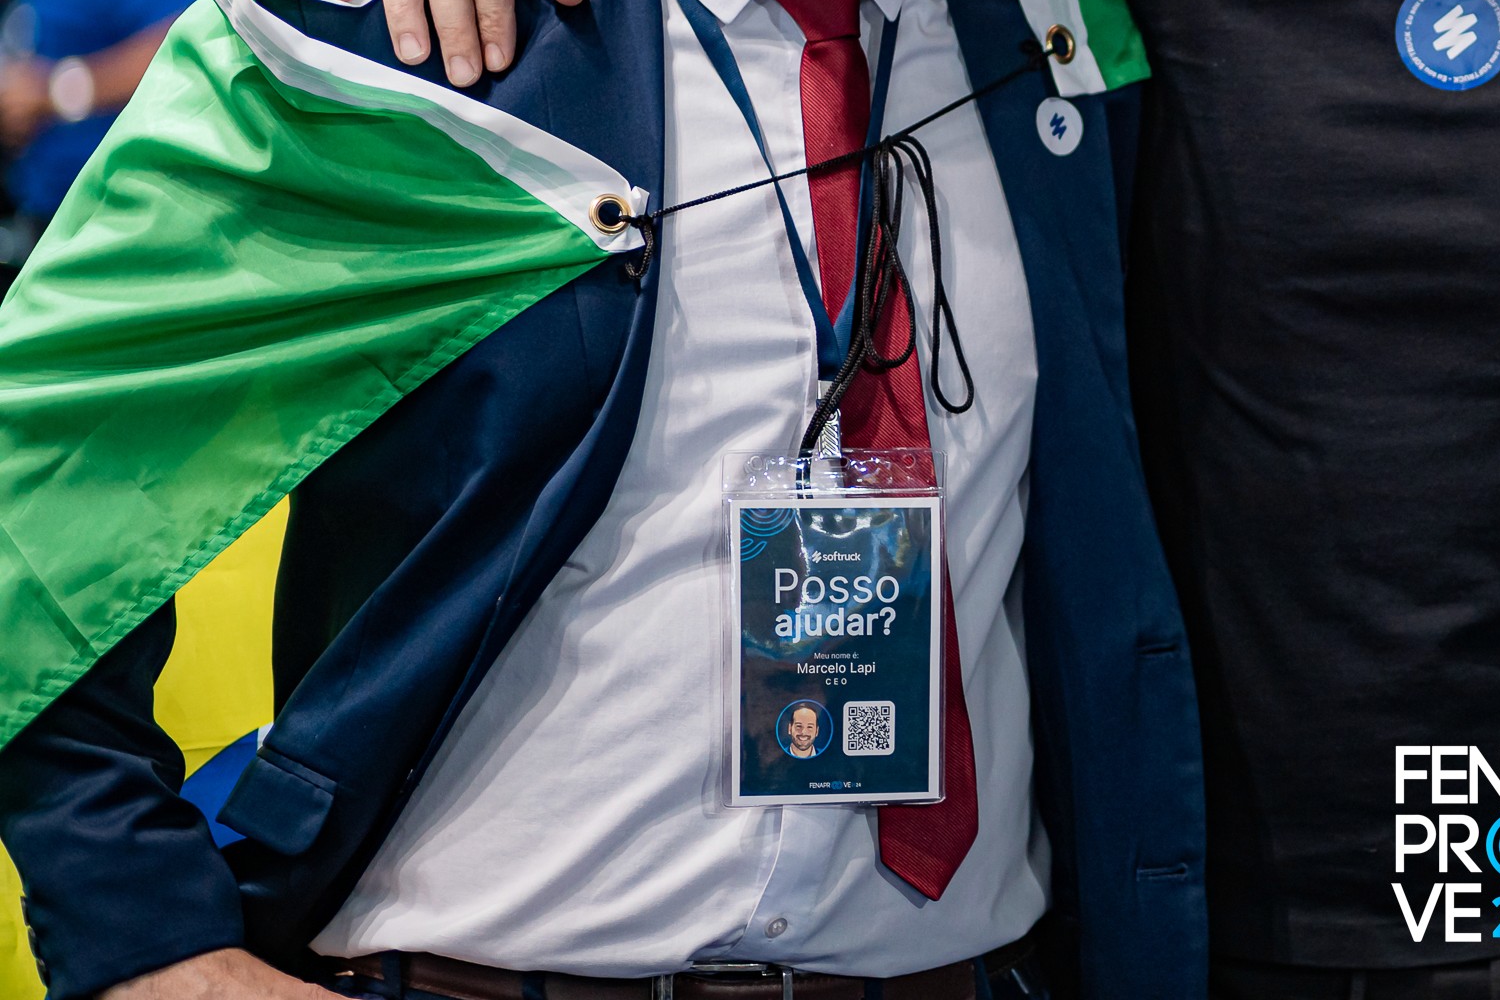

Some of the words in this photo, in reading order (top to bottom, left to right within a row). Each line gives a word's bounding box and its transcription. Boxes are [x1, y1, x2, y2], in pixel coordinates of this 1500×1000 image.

[822, 551, 861, 561] softruck
[774, 568, 900, 604] Posso
[774, 606, 897, 644] ajudar?
[797, 662, 846, 674] Marcelo
[850, 661, 876, 676] Lapi
